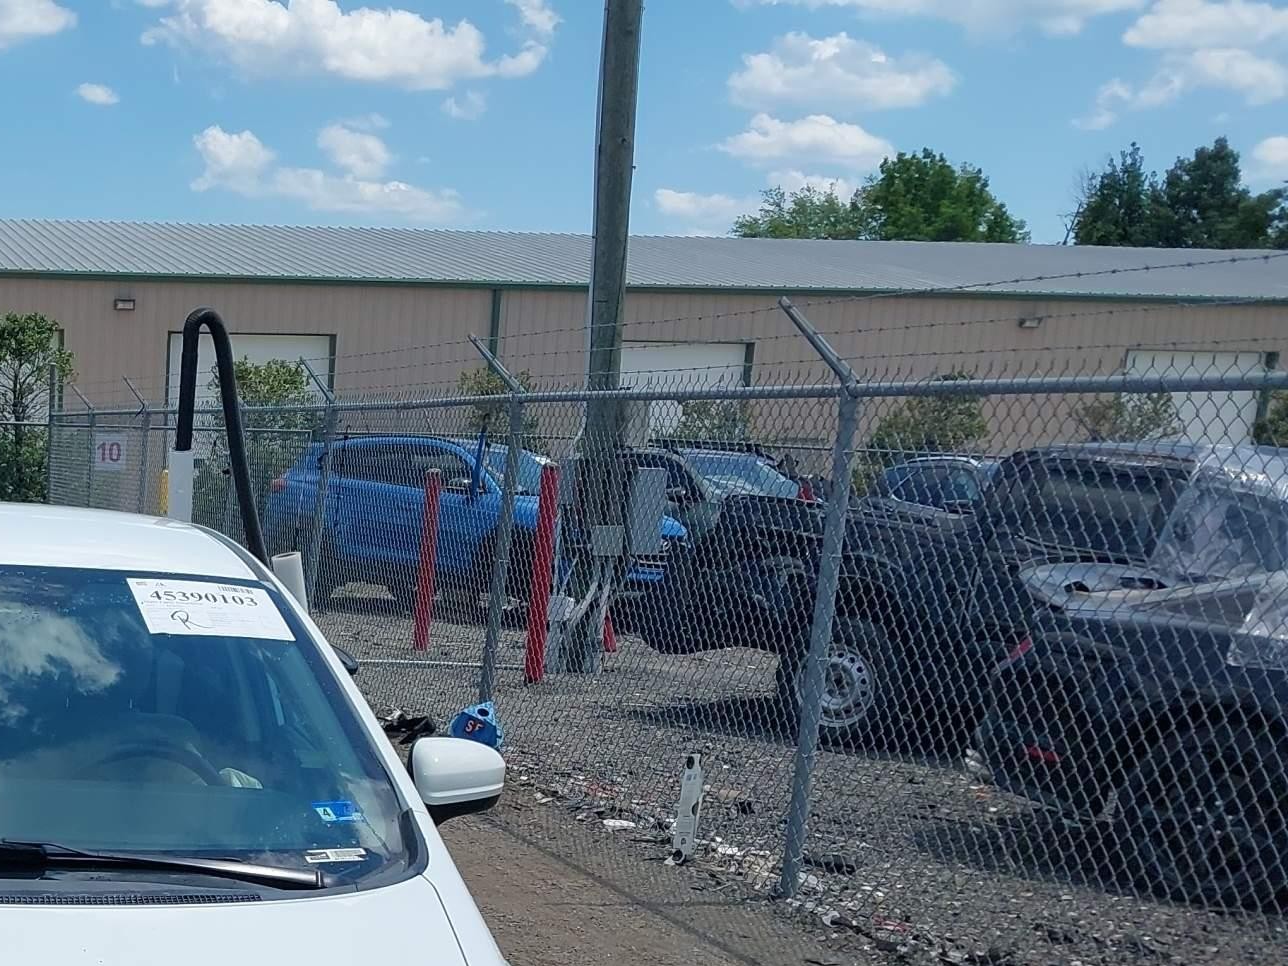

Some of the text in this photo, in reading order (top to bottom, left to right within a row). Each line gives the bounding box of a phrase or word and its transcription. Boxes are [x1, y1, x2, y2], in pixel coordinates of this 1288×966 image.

[97, 442, 121, 462] 10
[150, 590, 258, 607] 45390103
[323, 808, 331, 817] 4
